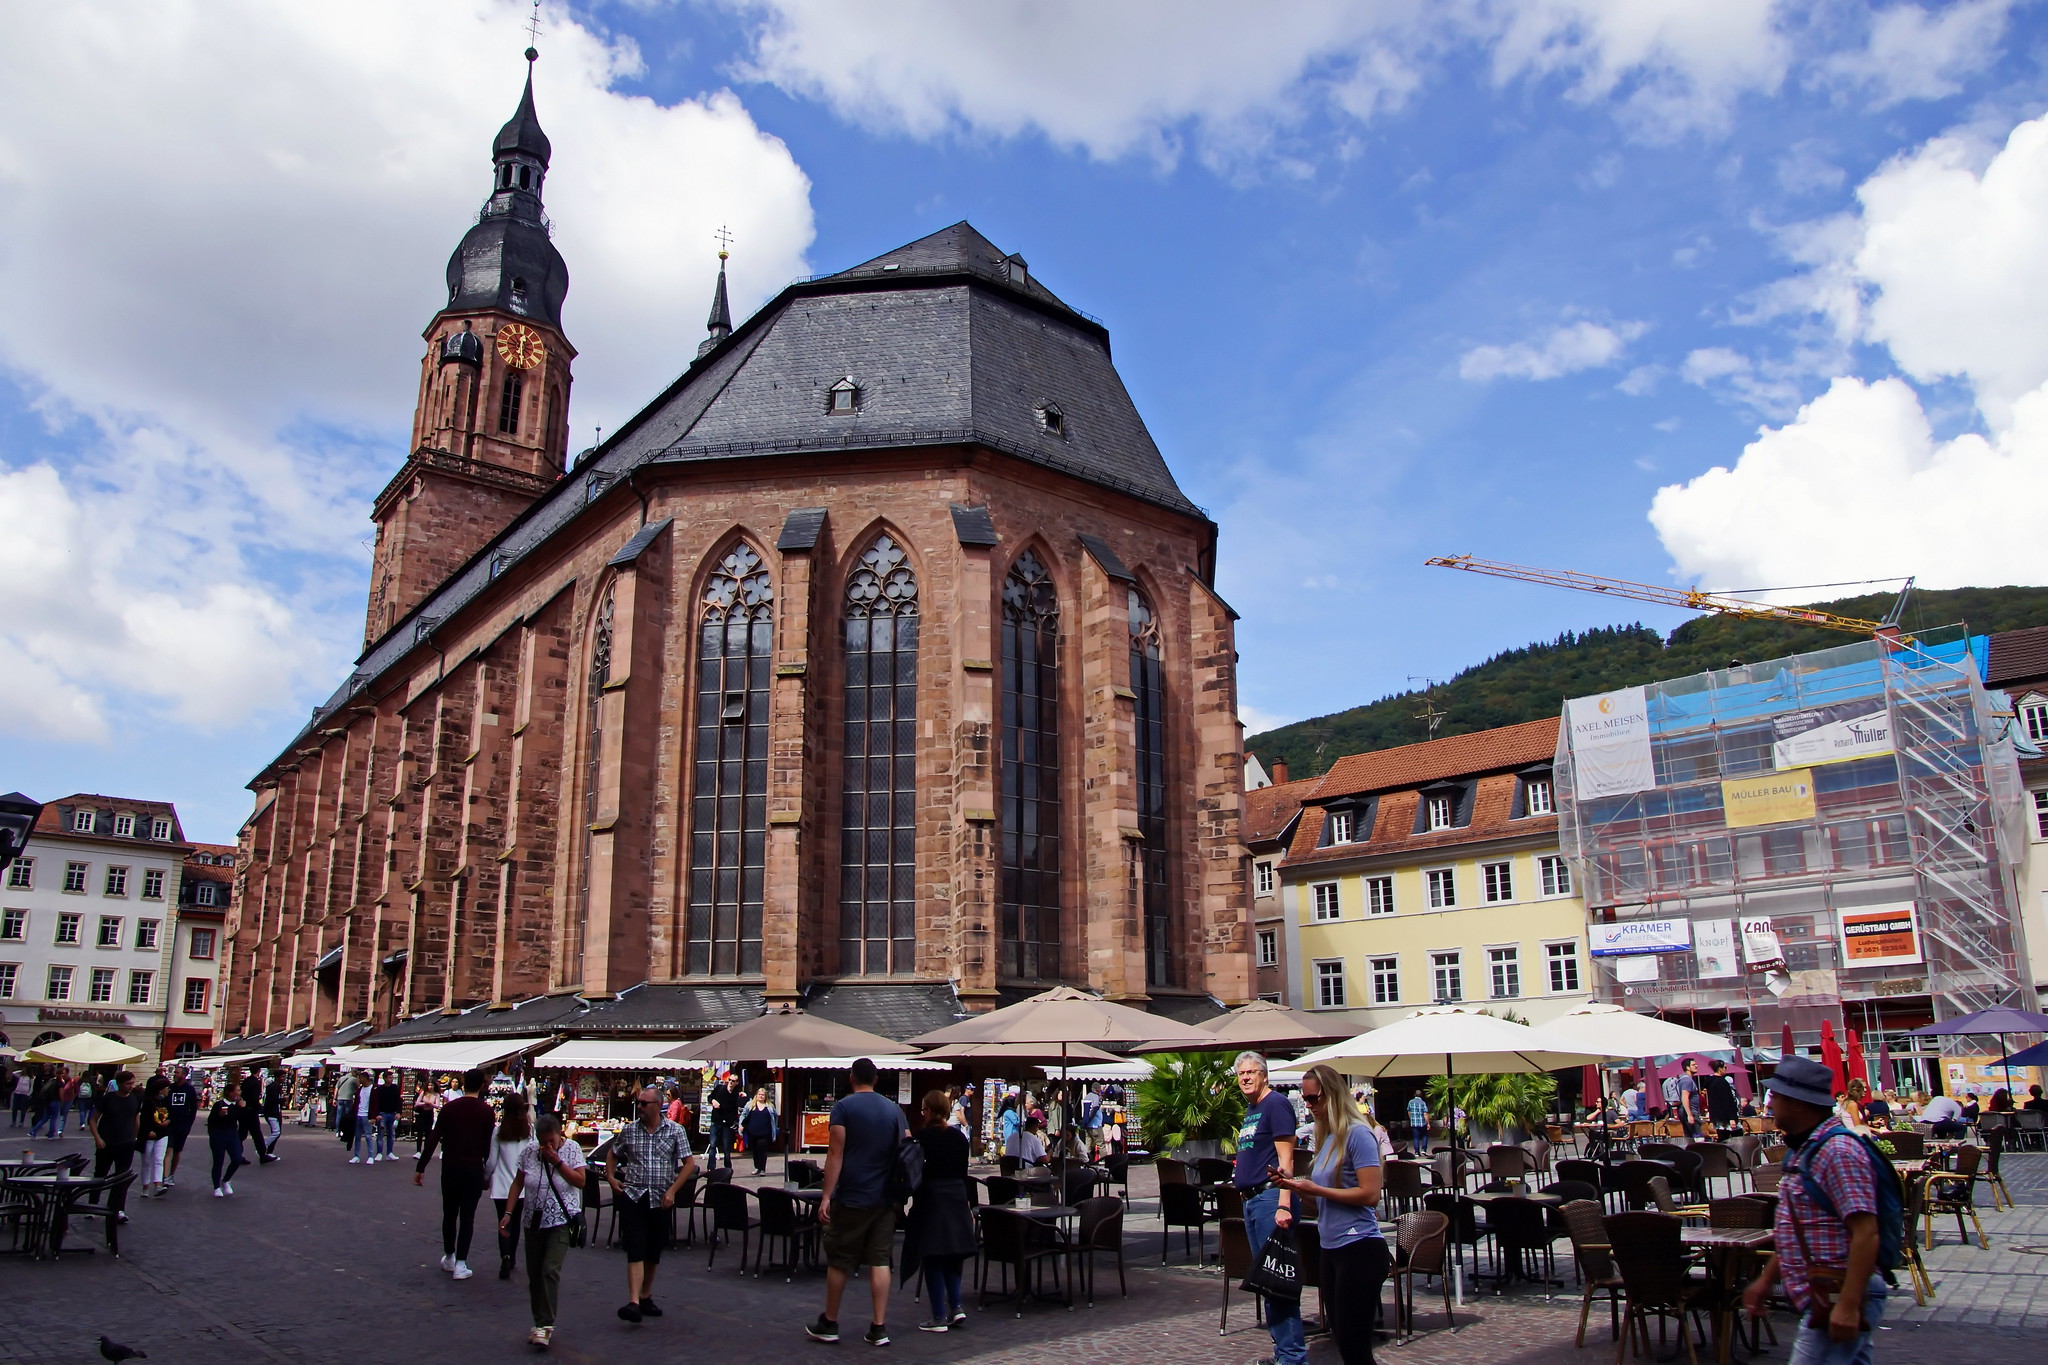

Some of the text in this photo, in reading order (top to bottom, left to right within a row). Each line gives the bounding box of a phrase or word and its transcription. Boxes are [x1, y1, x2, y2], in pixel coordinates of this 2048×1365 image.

[1575, 713, 1644, 733] AXEL MEISEN
[1590, 729, 1630, 740] Immobilien
[1834, 738, 1853, 748] Richard
[1732, 785, 1792, 800] MÜLLER BAU
[1622, 922, 1672, 935] KRÄMER
[1845, 921, 1911, 934] GERÜSTBAU GMBH
[1858, 937, 1903, 947] Ludwigshafen
